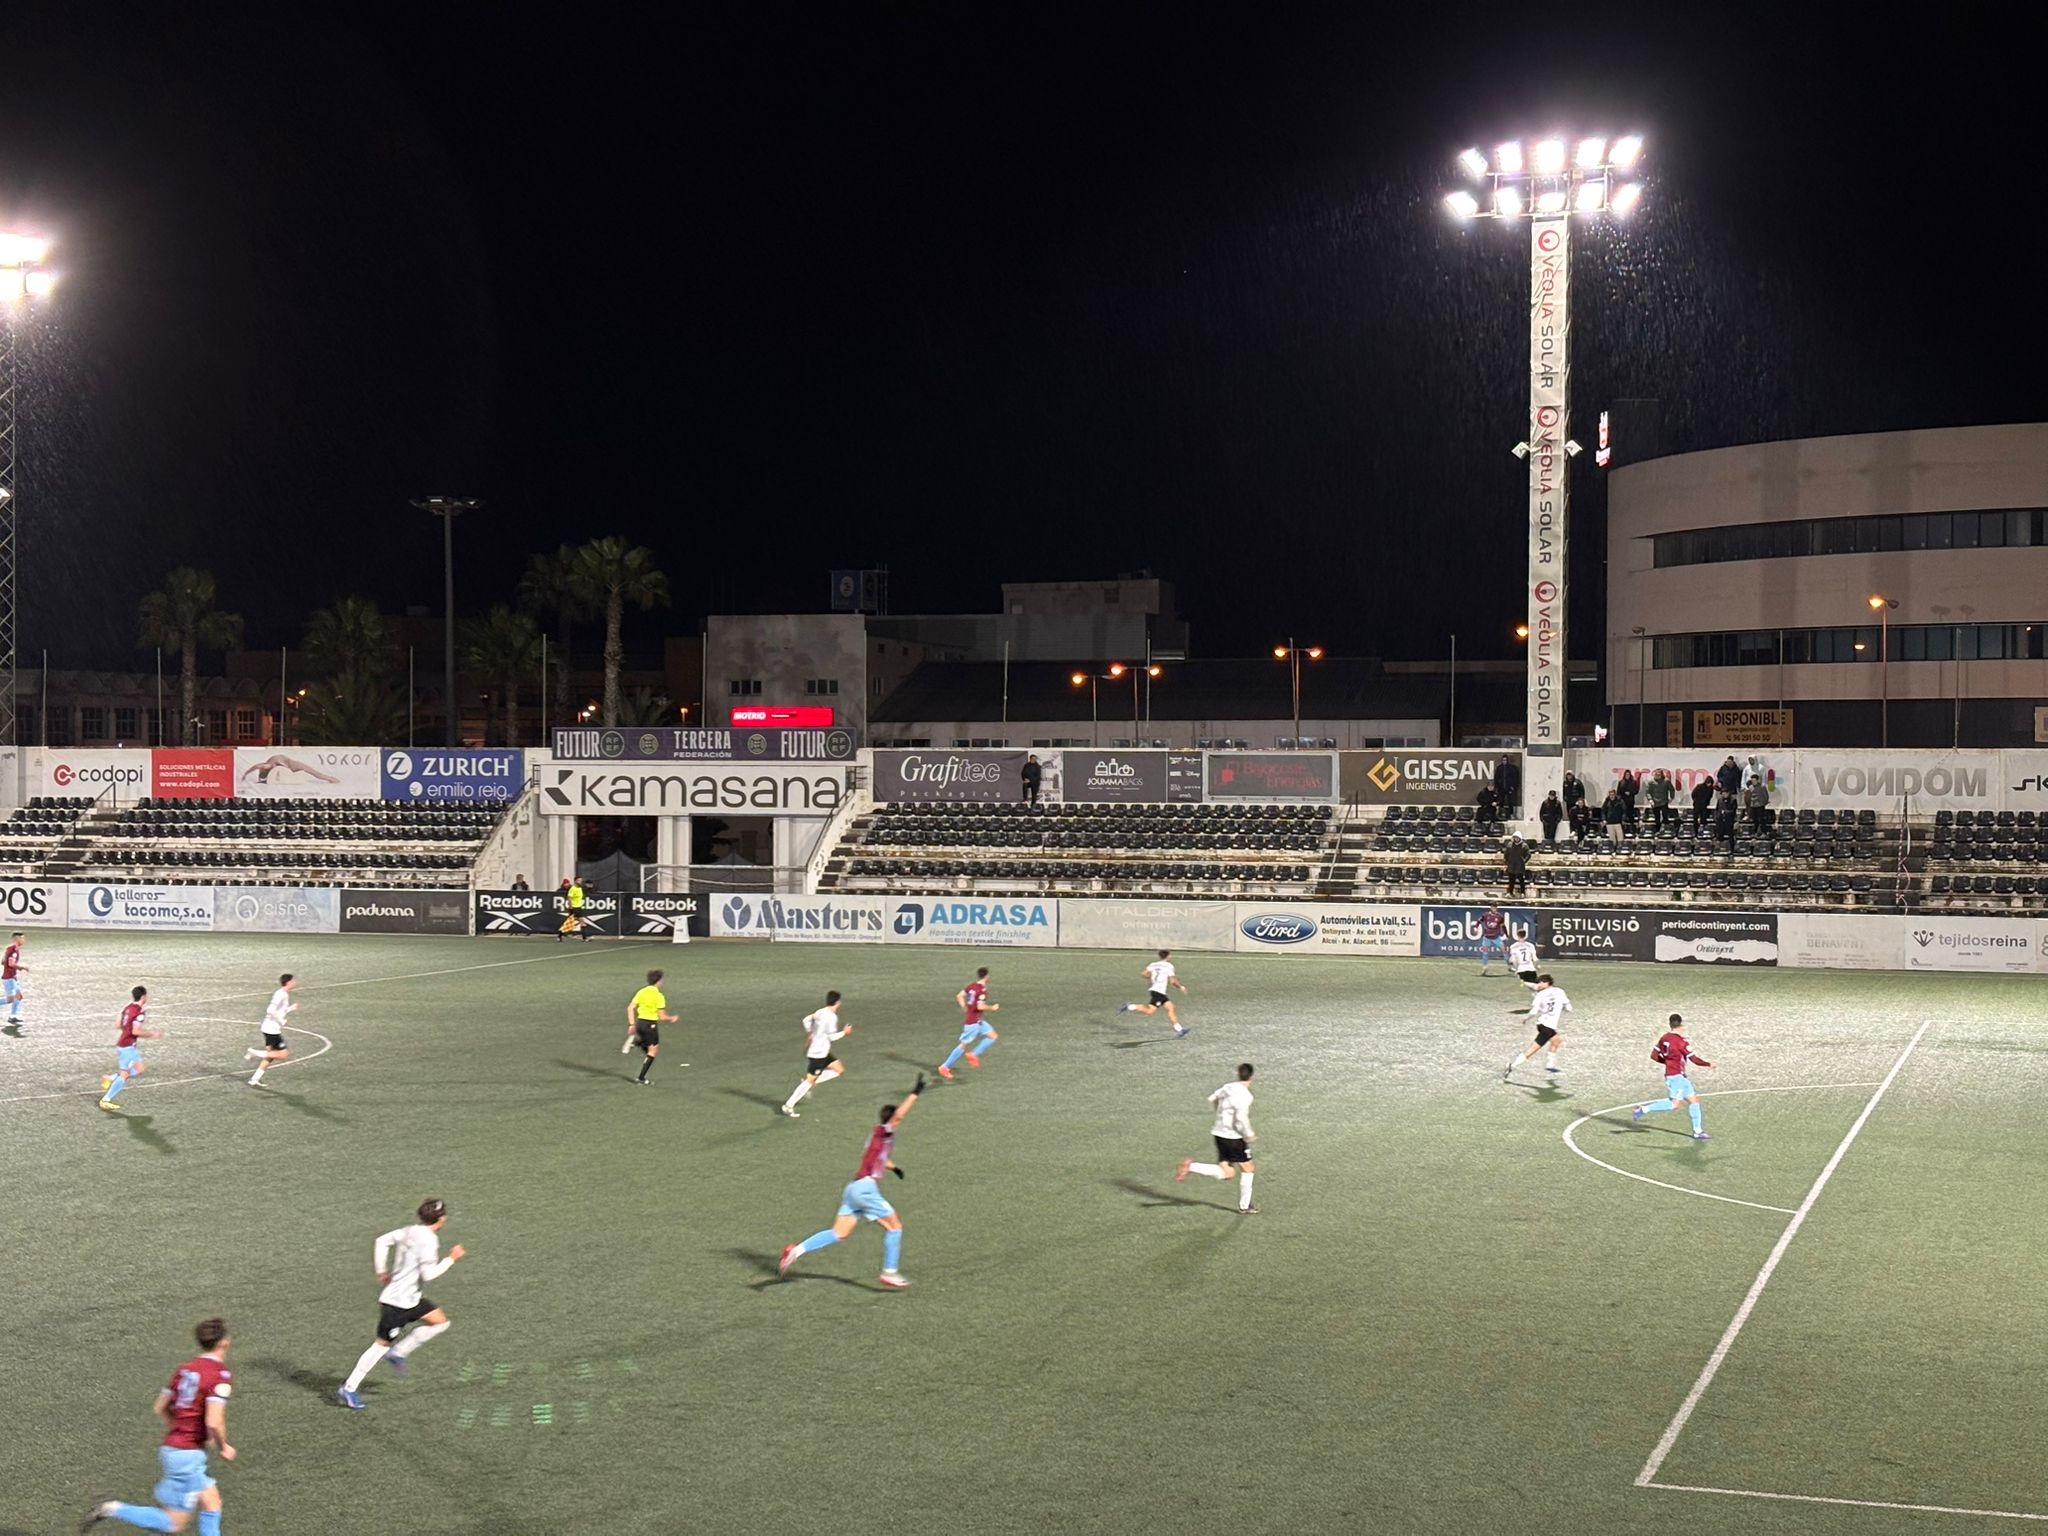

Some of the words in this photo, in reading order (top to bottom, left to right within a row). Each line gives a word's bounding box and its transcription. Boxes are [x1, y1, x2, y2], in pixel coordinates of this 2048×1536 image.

[1541, 256, 1554, 319] VEOLIA
[1541, 325, 1553, 388] SOLAR
[1540, 432, 1553, 495] VEOLIA
[1539, 501, 1552, 564] SOLAR
[1538, 606, 1551, 669] VEOLIA
[733, 711, 766, 720] MOTRIO
[1537, 675, 1550, 738] SOLAR
[1714, 711, 1786, 726] DISPONIBLE
[557, 731, 600, 758] FUTUR
[673, 730, 732, 749] TERCERA
[781, 731, 826, 758] FUTUR
[78, 765, 144, 786] codopi
[421, 757, 509, 777] ZURICH
[900, 755, 1001, 789] Grafitec
[1404, 758, 1495, 780] GISSAN
[160, 780, 220, 789] www.codopi.com
[427, 781, 474, 797] emilio
[478, 781, 507, 800] reig
[580, 774, 840, 809] kamasana
[1405, 782, 1457, 791] INGENIEROS
[264, 903, 308, 916] cisne
[346, 904, 415, 919] paduana
[479, 894, 543, 909] Reebok
[632, 897, 697, 912] Reebok
[756, 900, 883, 931] Masters
[929, 903, 1049, 927] ADRASA
[1320, 915, 1370, 925] Automóviles
[1371, 916, 1380, 925] La
[1382, 916, 1400, 927] Vall,
[1401, 917, 1416, 926] S.L.
[1428, 910, 1529, 940] bablu
[1662, 920, 1770, 932] periodicontinyent.com
[1255, 916, 1301, 938] Ford
